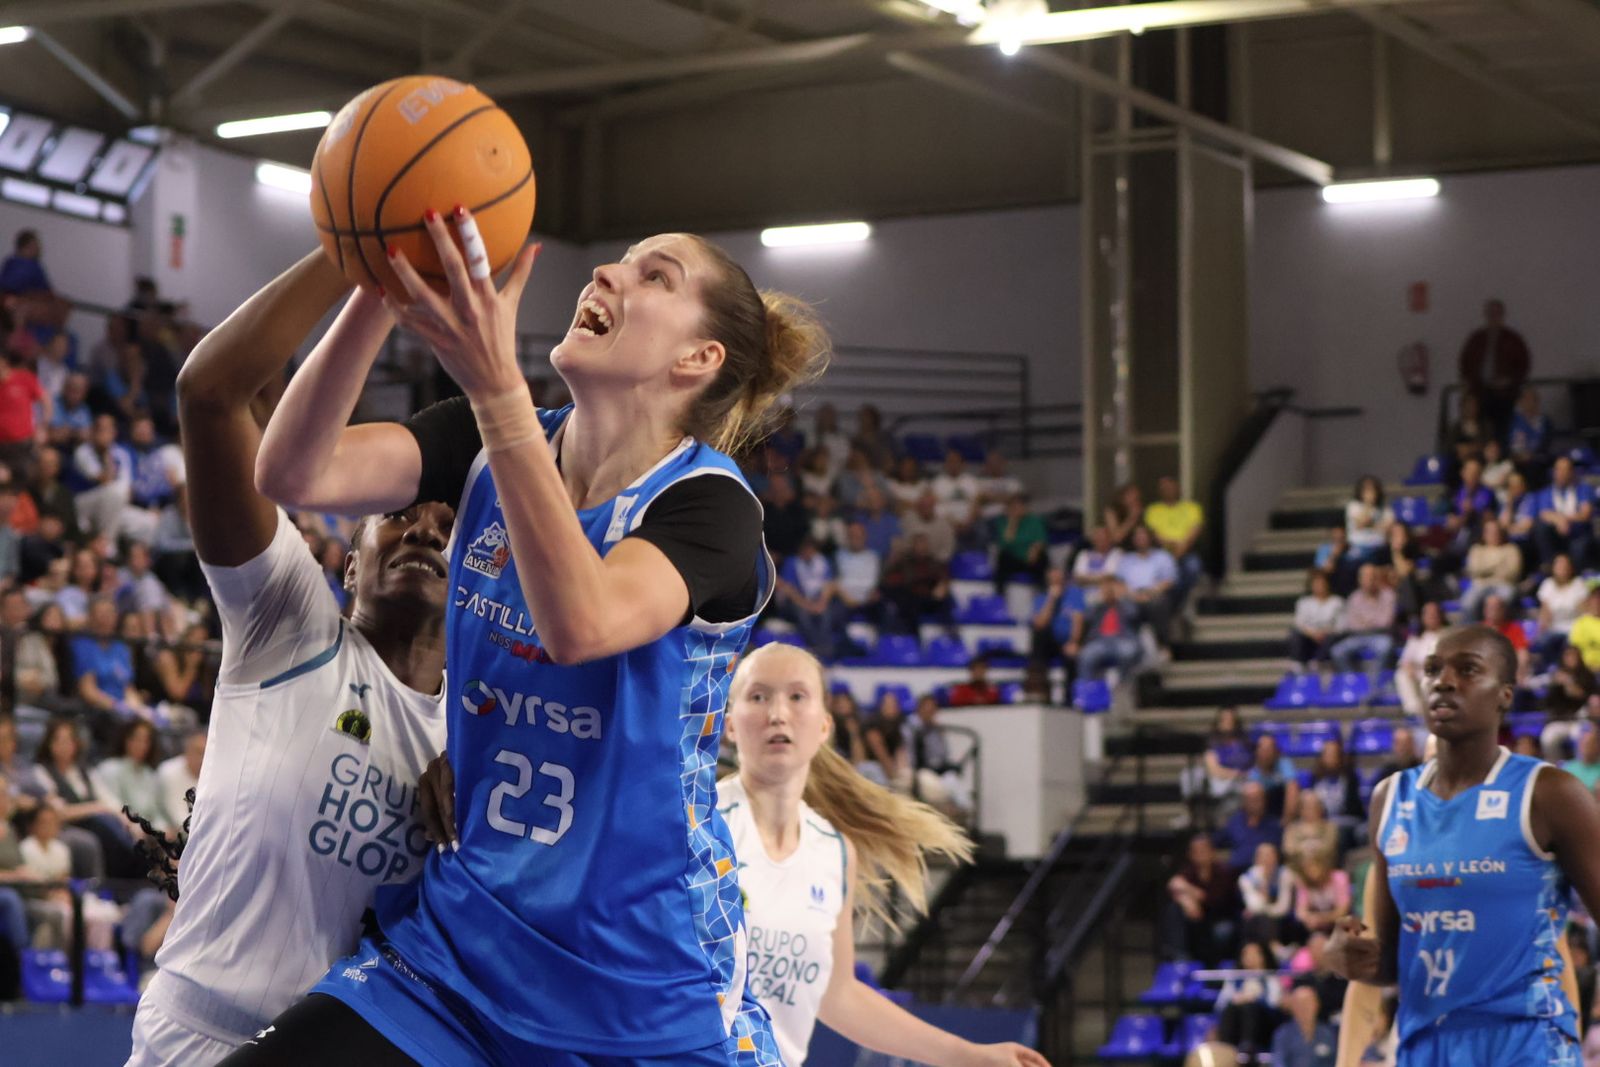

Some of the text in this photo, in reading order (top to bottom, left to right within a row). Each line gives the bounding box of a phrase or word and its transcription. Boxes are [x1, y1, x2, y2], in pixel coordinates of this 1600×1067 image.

[455, 586, 536, 637] CASTILL
[486, 749, 575, 846] 23
[1459, 856, 1505, 873] LEÓN
